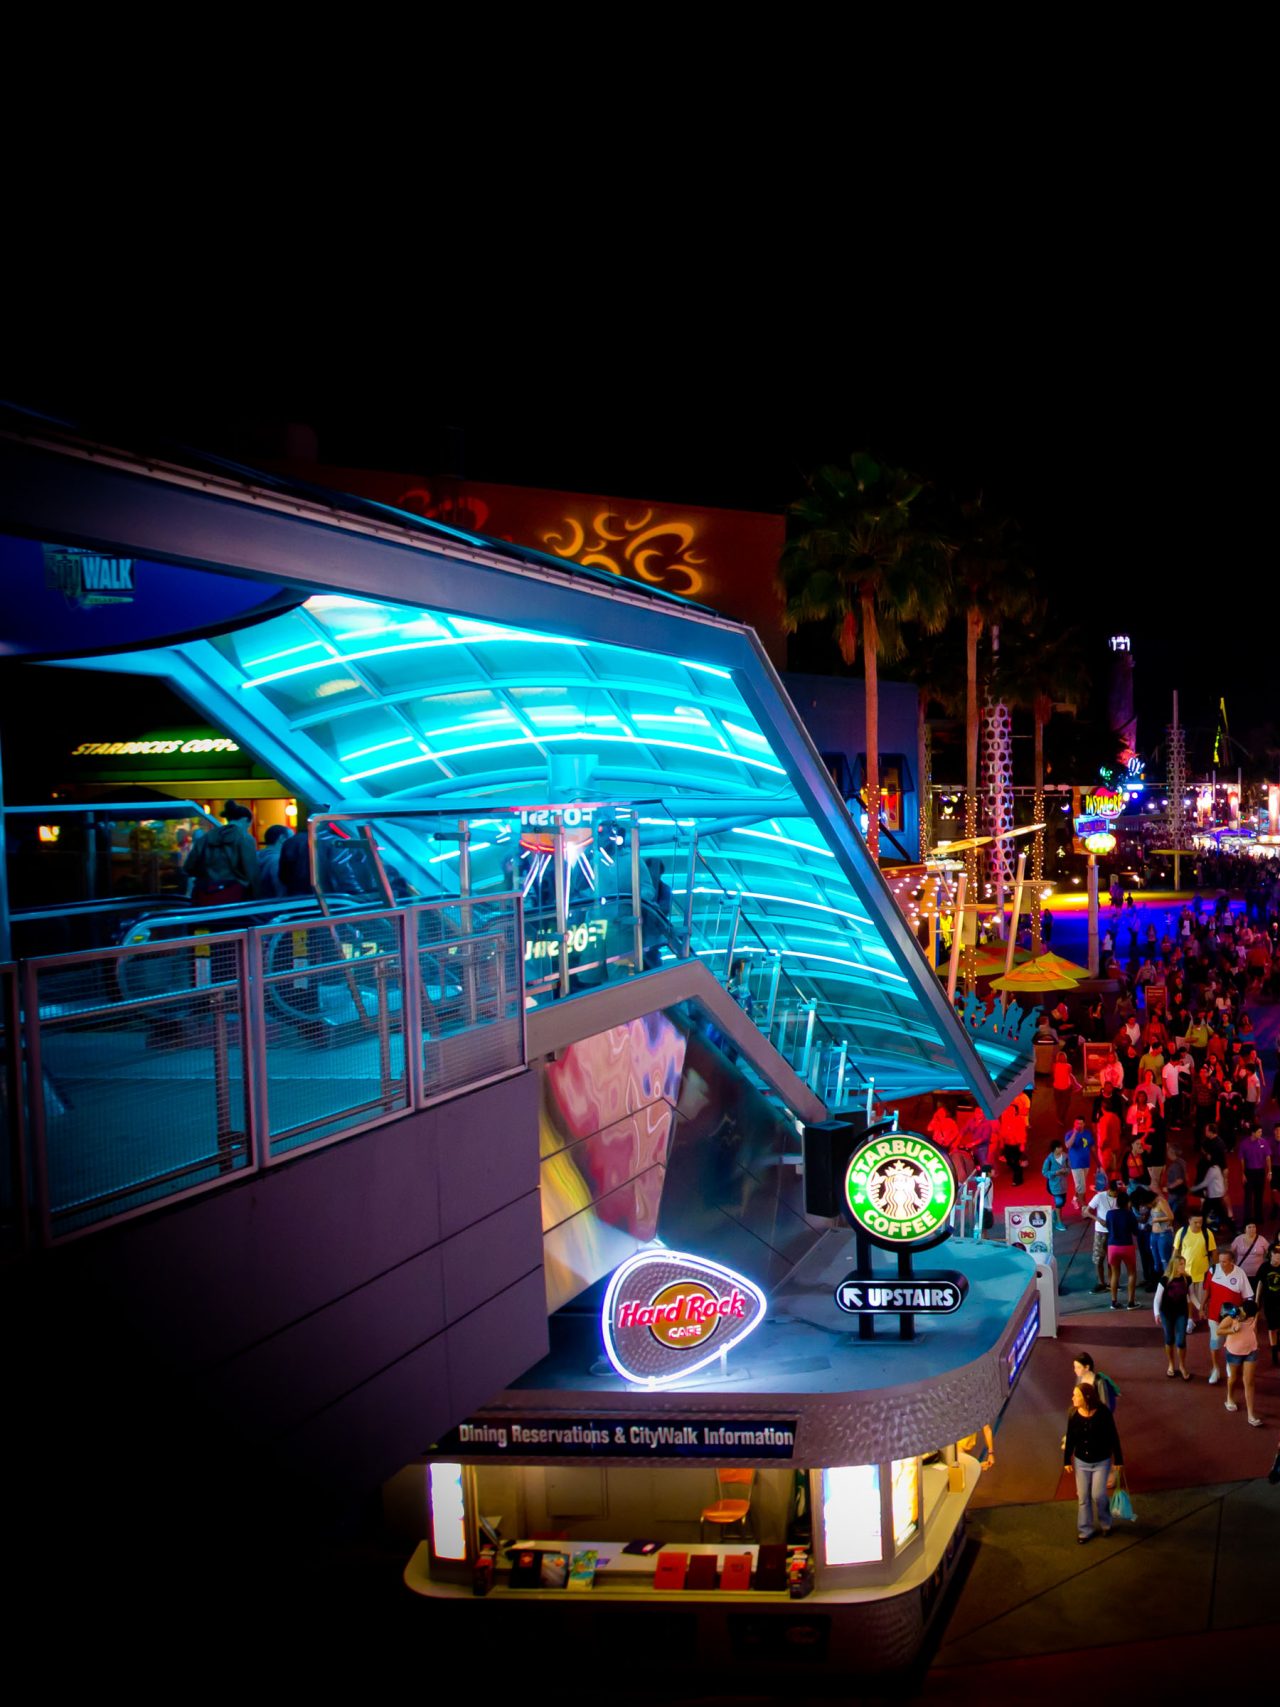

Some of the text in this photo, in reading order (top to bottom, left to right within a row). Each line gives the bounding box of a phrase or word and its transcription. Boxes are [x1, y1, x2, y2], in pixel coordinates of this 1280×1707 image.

[82, 556, 135, 590] WALK
[72, 740, 185, 755] STARBUCKS
[851, 1139, 949, 1186] STARBUCKS
[863, 1209, 938, 1237] COFFEE
[618, 1288, 746, 1329] Hard Rock
[868, 1288, 954, 1307] UPSTAIRS
[668, 1324, 702, 1338] CAFE
[459, 1423, 794, 1449] Dining Reservations & CityWalk Information
